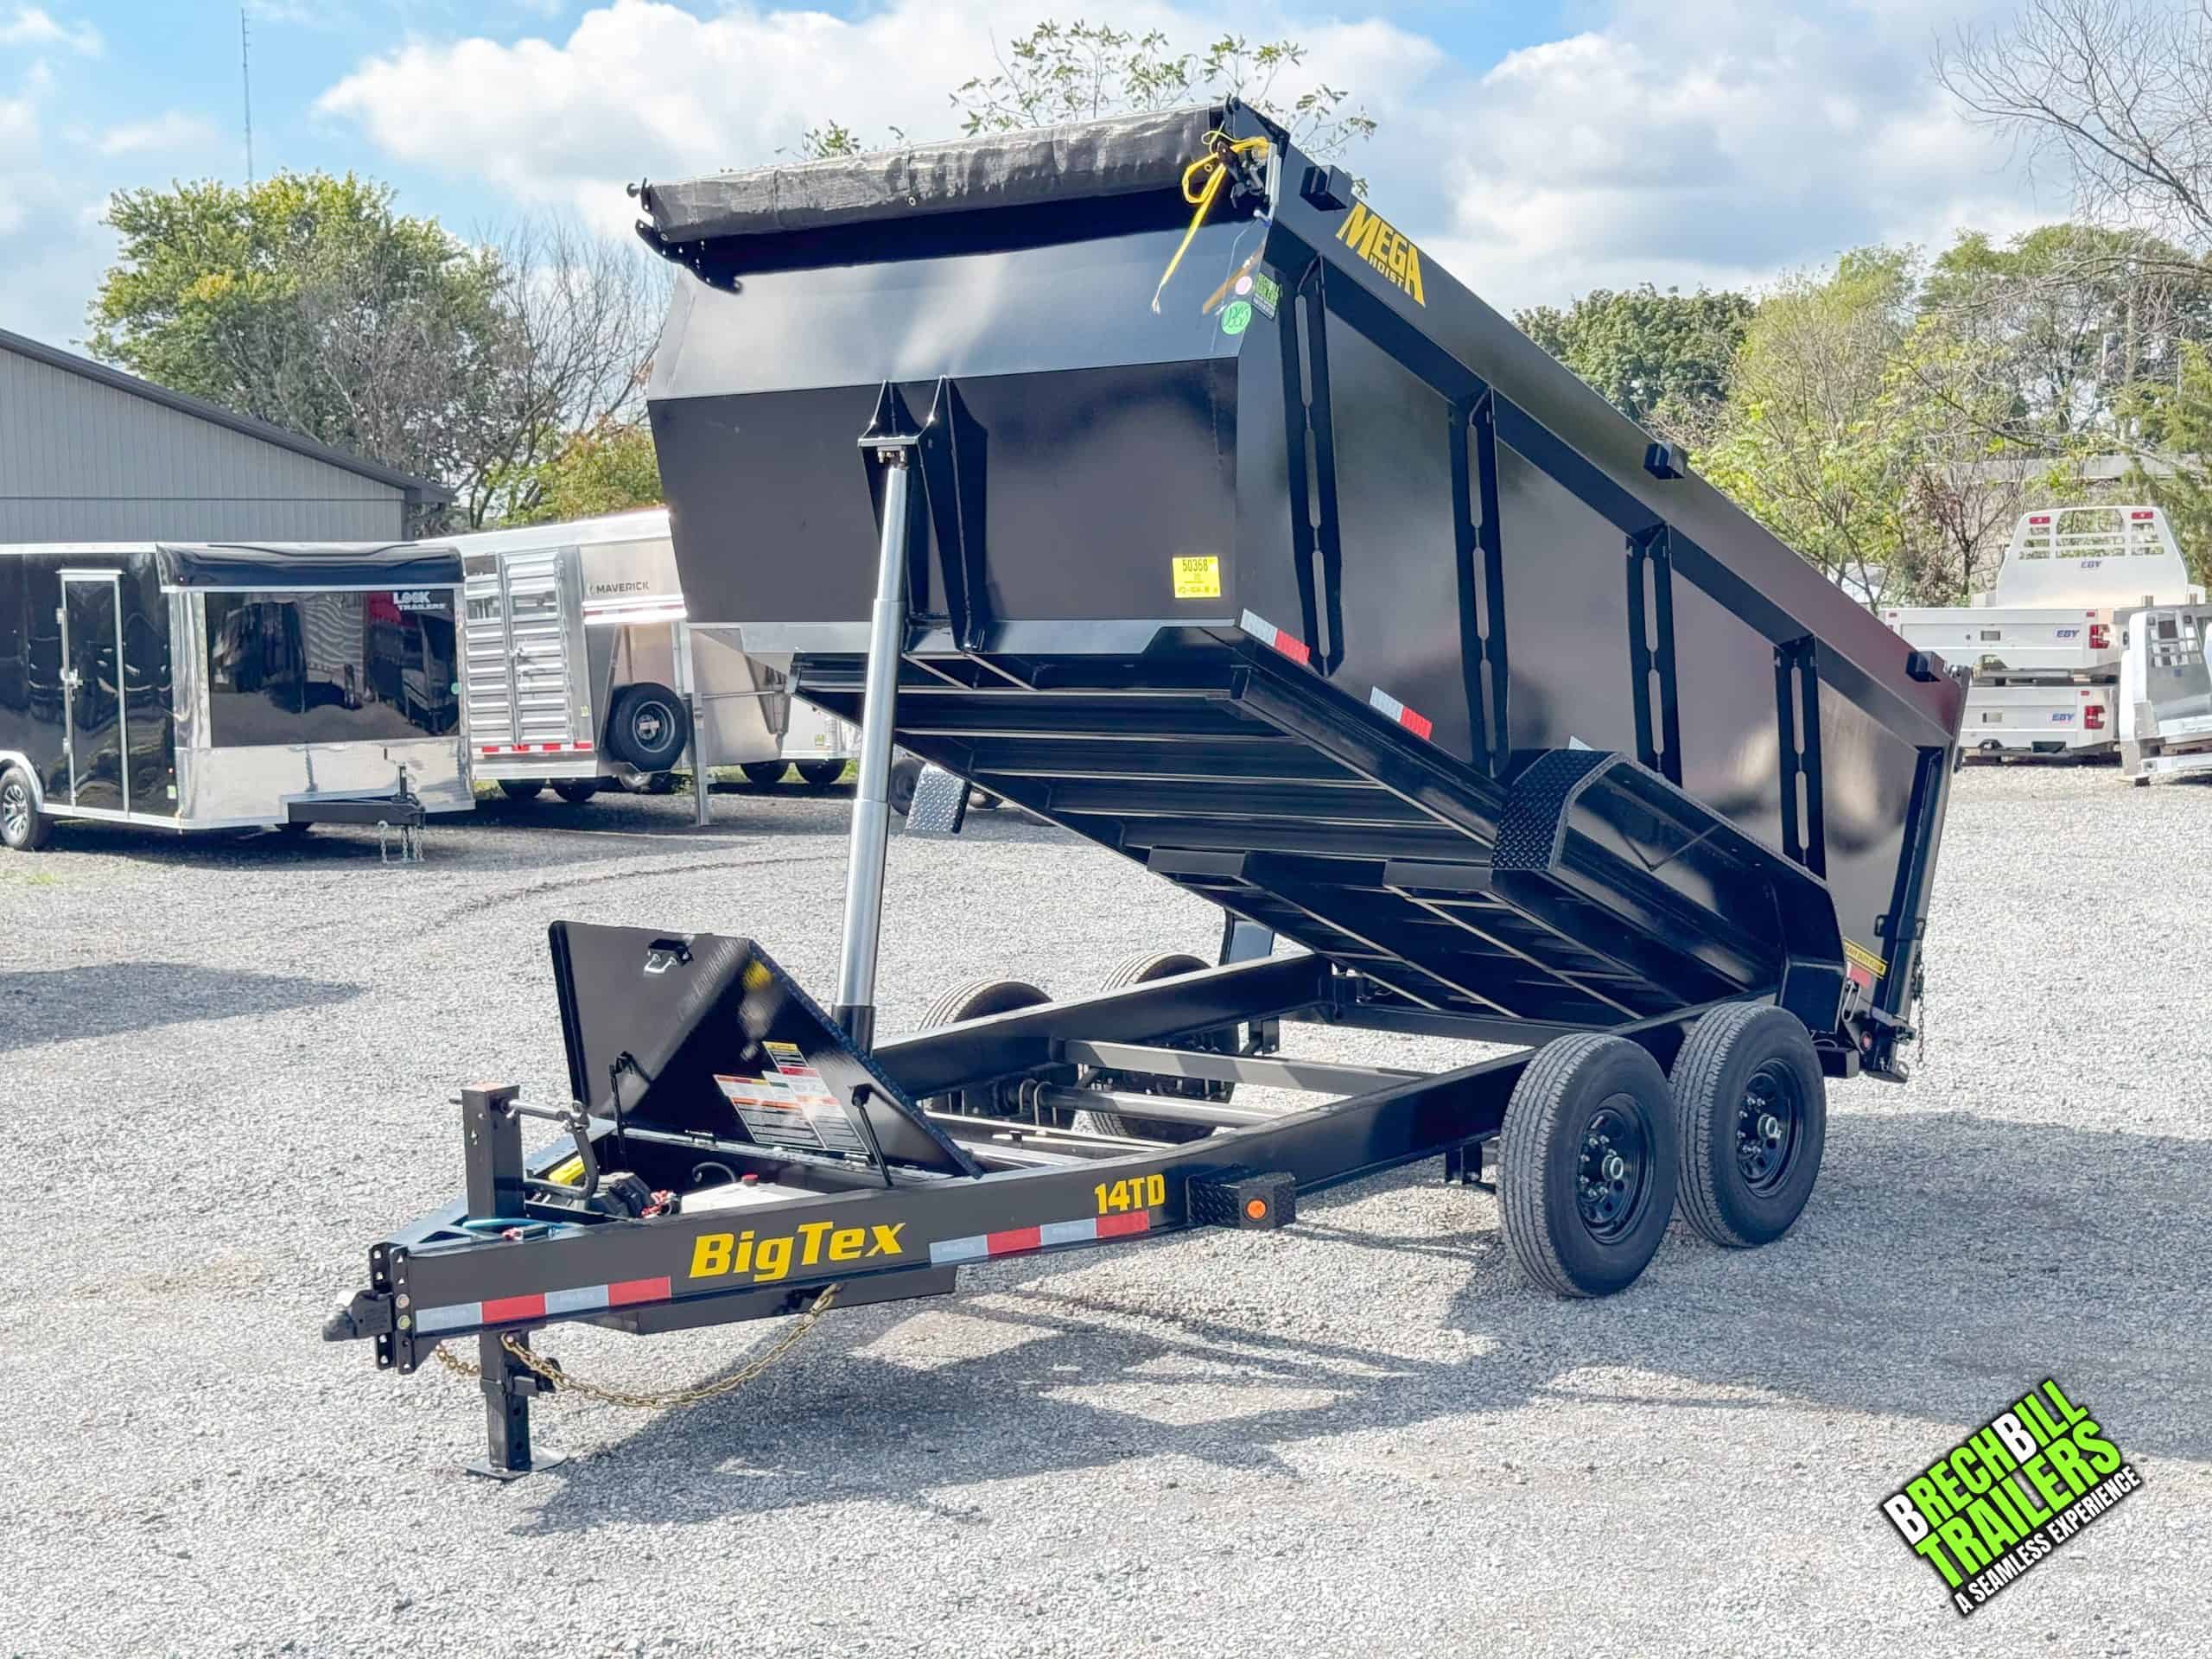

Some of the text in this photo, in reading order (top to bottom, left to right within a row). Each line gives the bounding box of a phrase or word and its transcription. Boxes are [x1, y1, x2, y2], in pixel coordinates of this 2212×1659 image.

[1335, 201, 1426, 308] MEGA
[1369, 254, 1404, 289] HOIST
[2081, 561, 2101, 569] EBY
[596, 581, 649, 594] MAVERICK
[2056, 629, 2080, 638] EBY
[2051, 712, 2075, 721] EBY
[1094, 1173, 1166, 1215] 14TD
